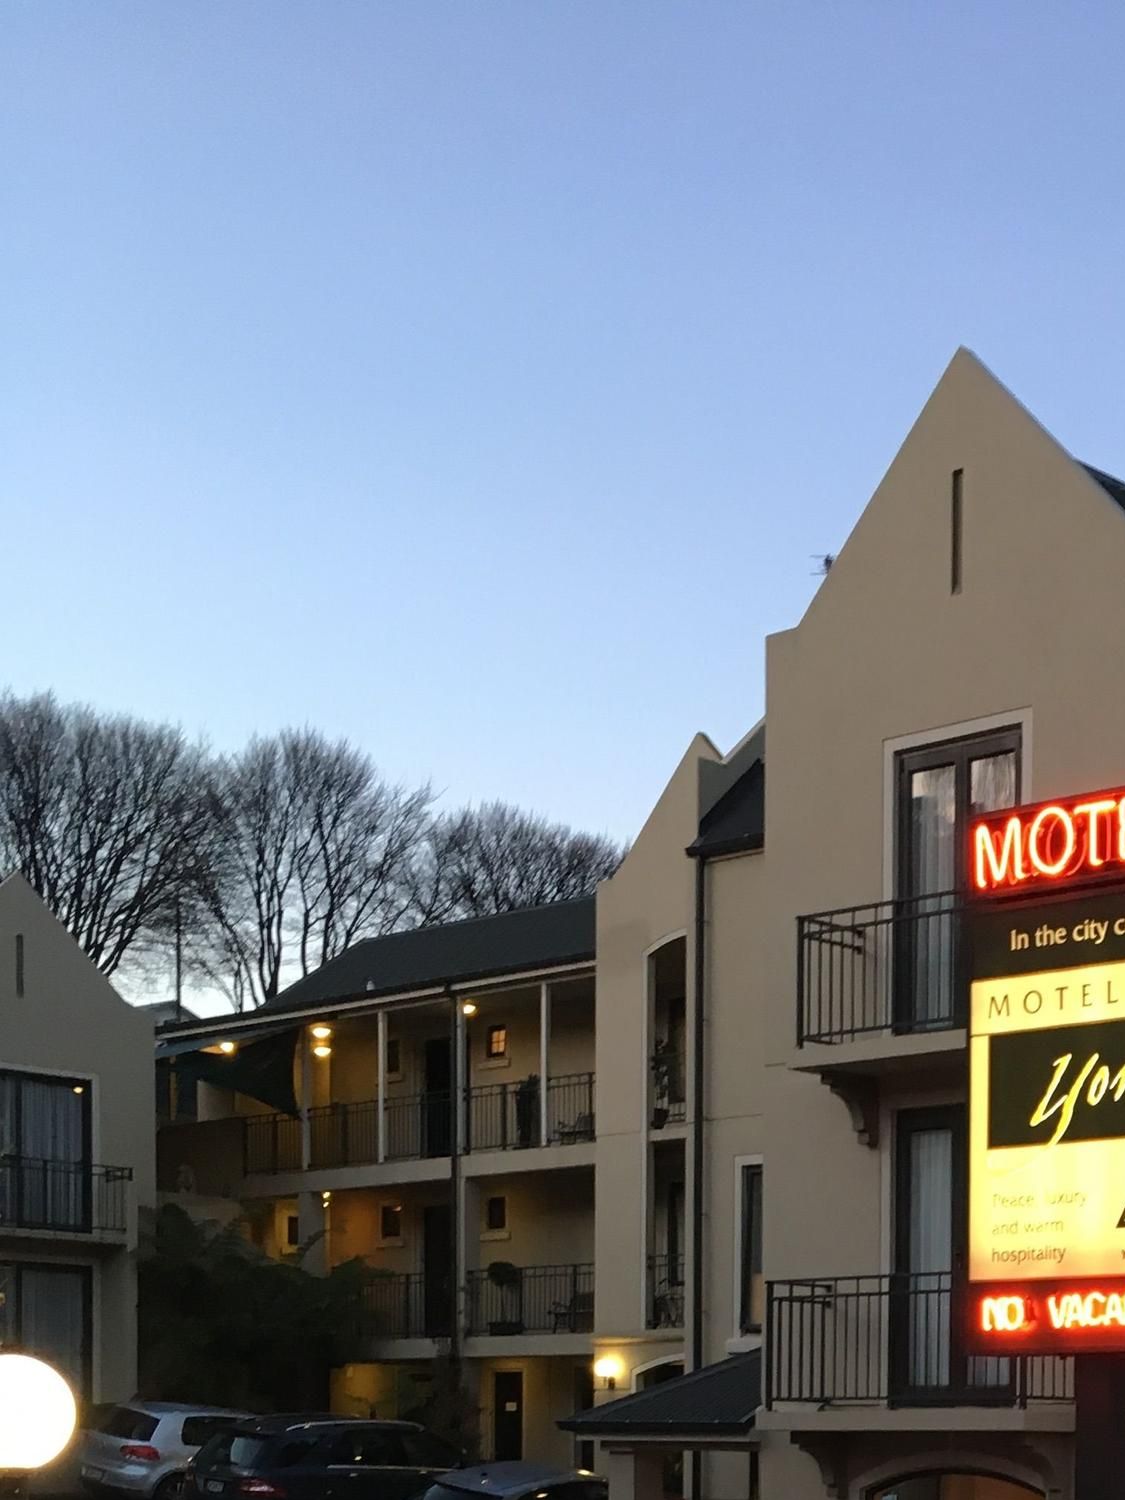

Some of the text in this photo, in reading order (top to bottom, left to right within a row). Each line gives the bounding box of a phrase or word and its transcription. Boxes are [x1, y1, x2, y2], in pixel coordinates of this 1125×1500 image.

[1010, 928, 1029, 951] In
[1034, 924, 1068, 948] the
[1072, 918, 1109, 945] city
[987, 979, 1119, 1020] MOTEL
[991, 1219, 1019, 1236] and
[991, 1244, 1067, 1266] hospitality
[981, 1295, 1026, 1332] NO
